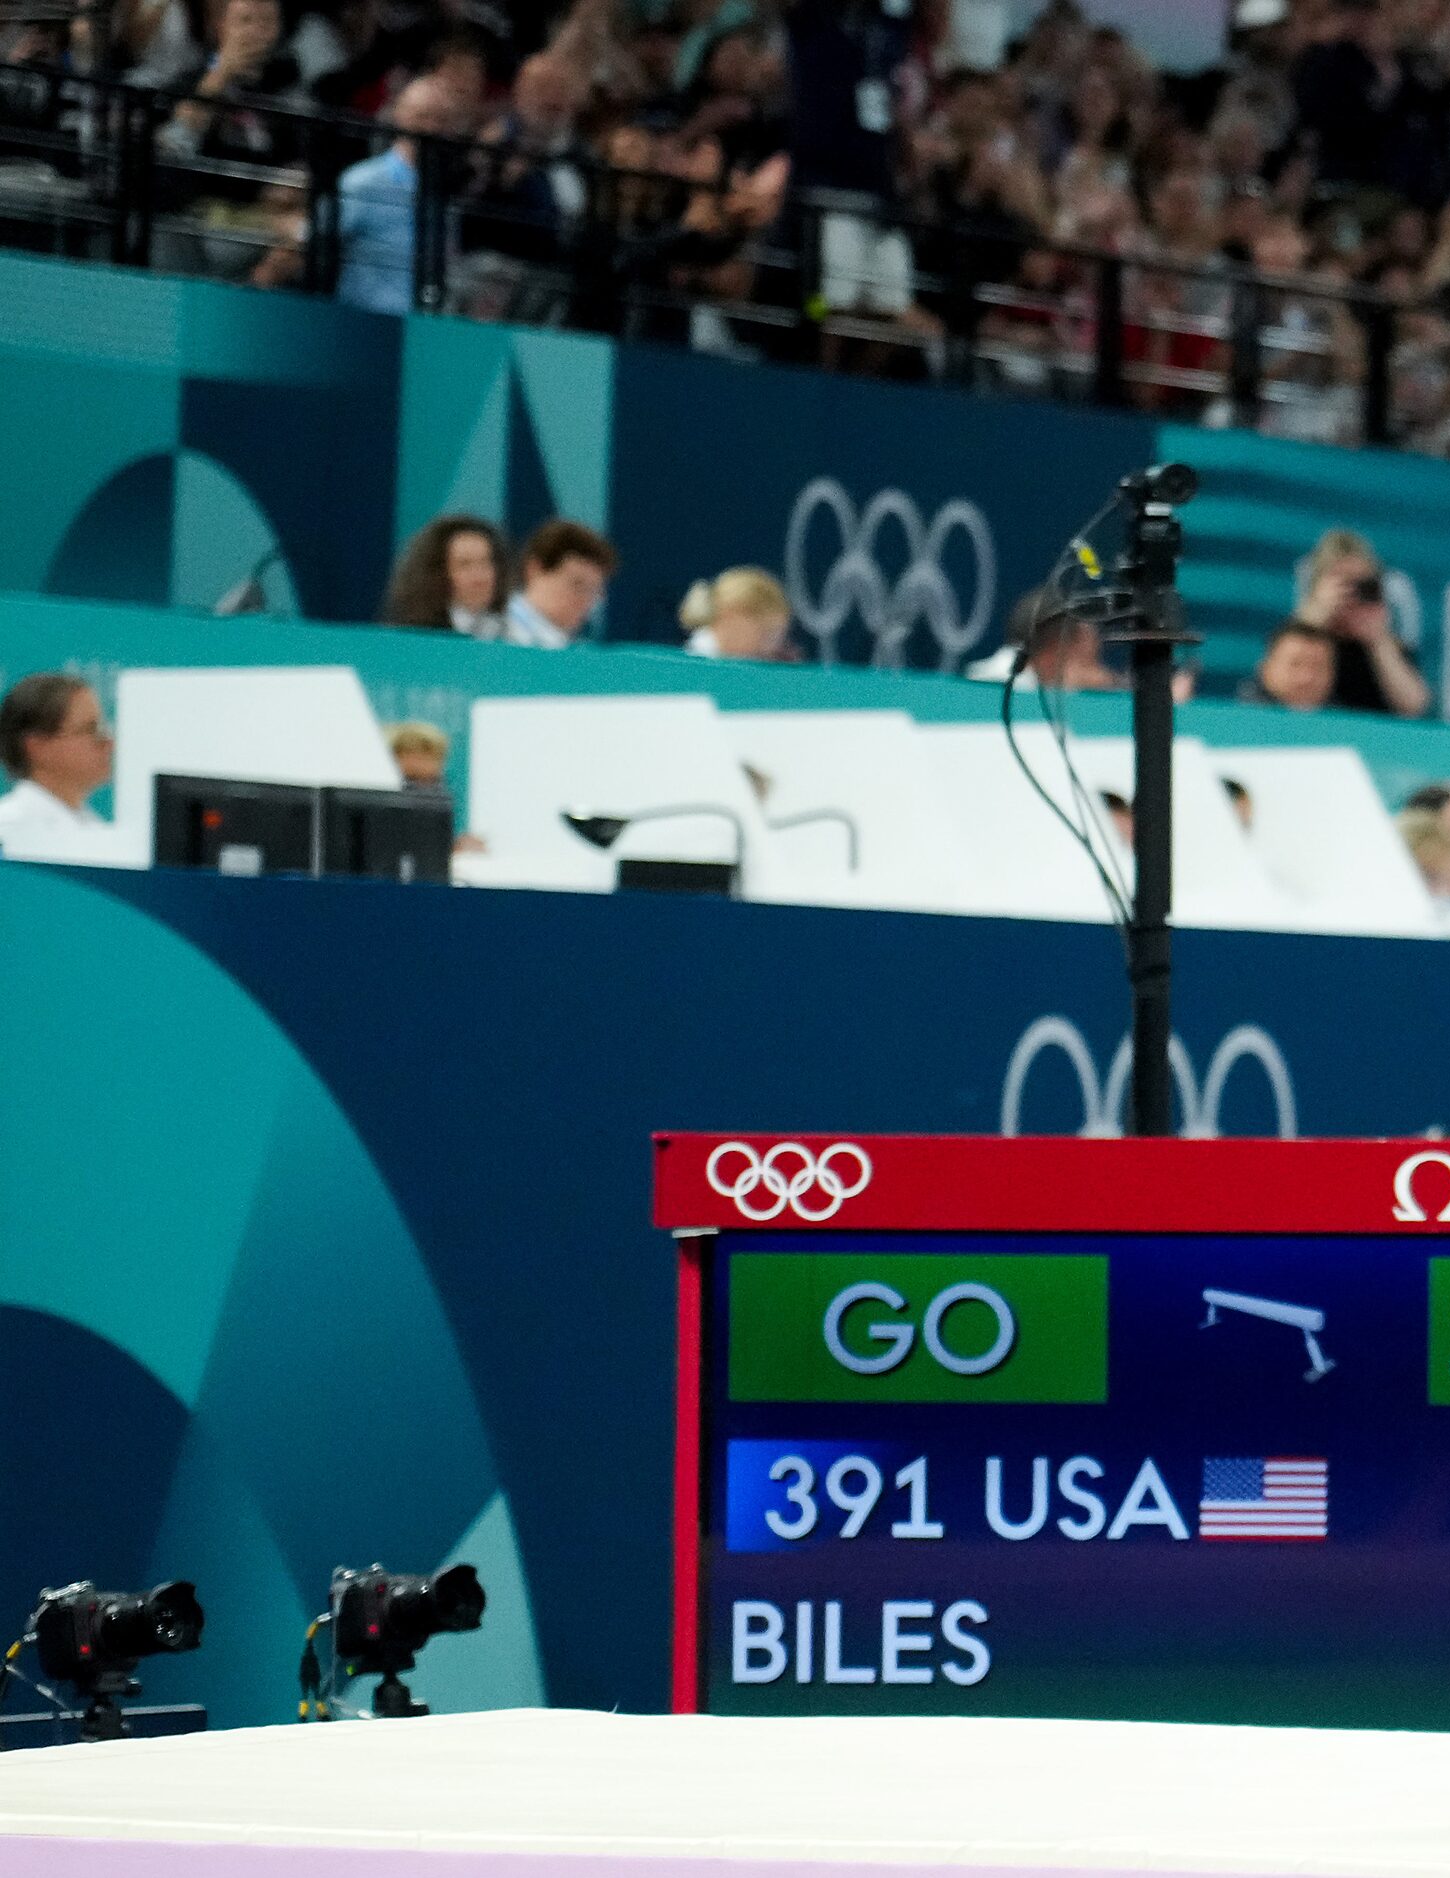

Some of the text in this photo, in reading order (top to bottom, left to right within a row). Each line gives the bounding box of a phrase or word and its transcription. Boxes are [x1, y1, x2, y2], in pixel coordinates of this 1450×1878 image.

[823, 1282, 1015, 1375] GO
[765, 1455, 1190, 1540] 391 USA
[731, 1601, 990, 1686] BILES
